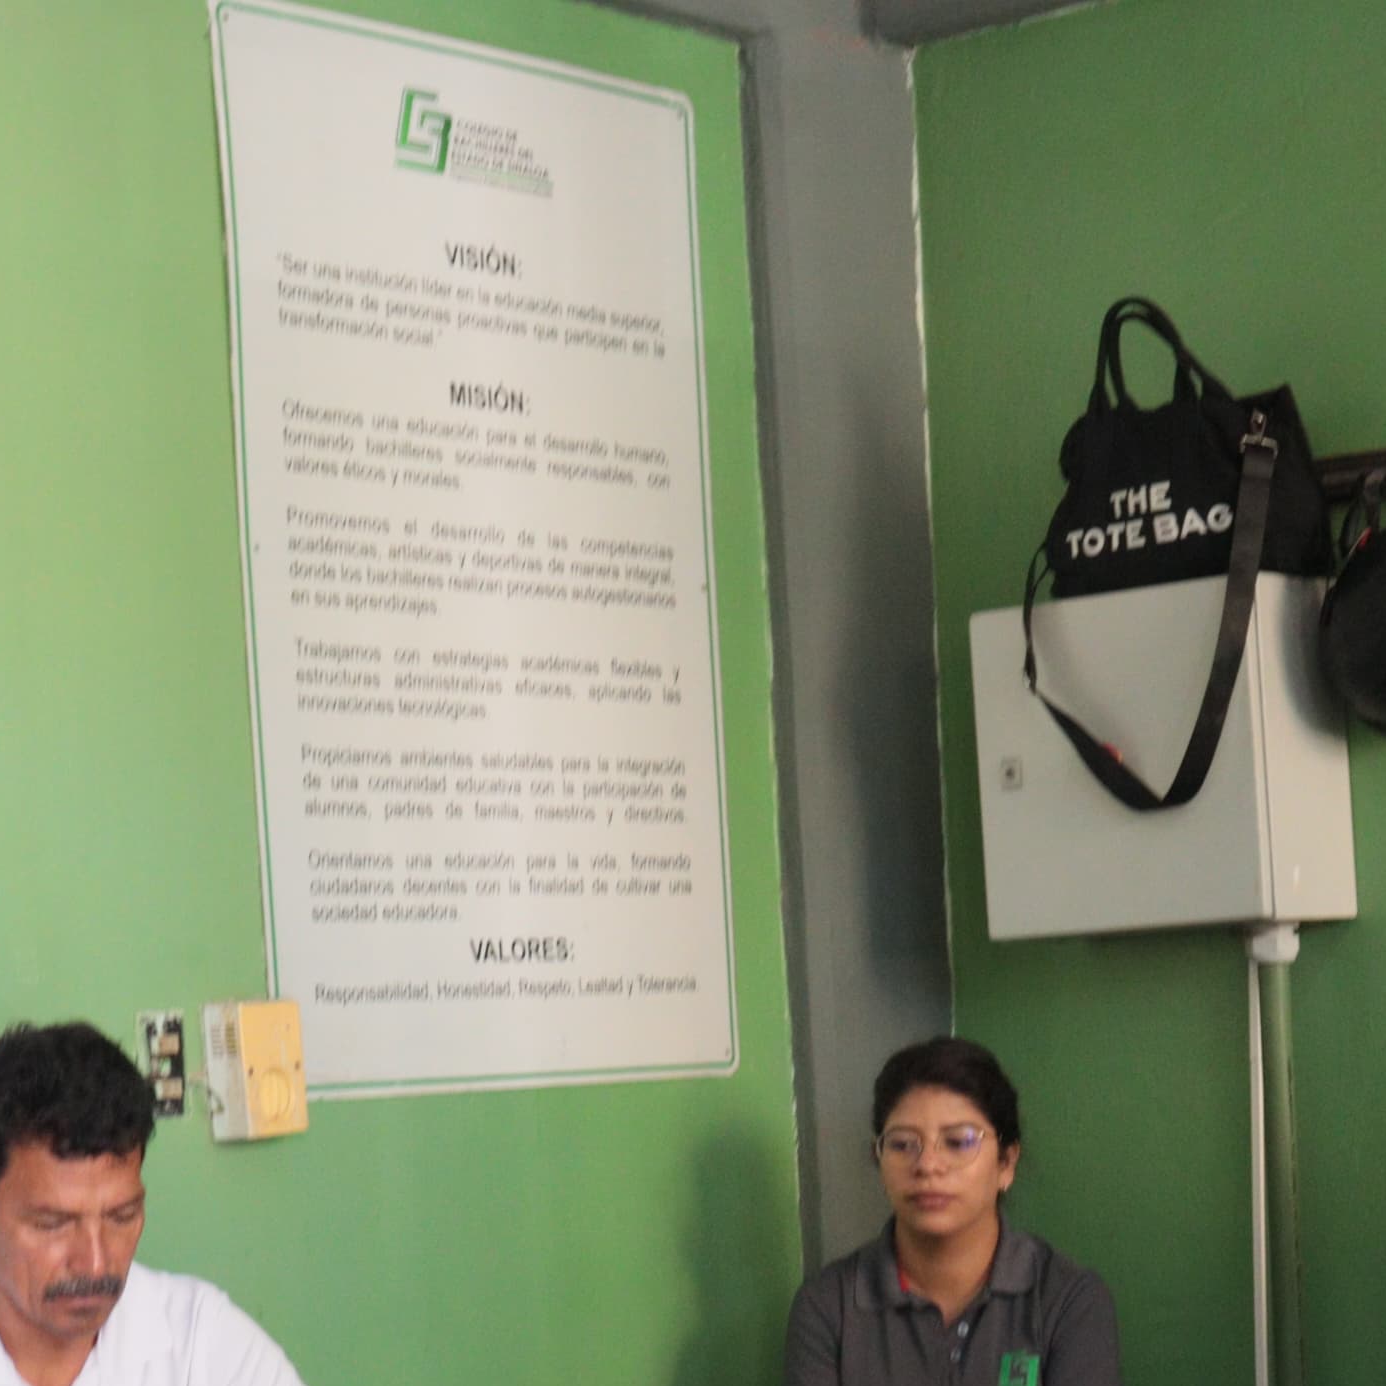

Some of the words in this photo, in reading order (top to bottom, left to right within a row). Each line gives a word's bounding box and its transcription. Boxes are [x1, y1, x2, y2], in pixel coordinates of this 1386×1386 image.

[445, 242, 522, 278] VISIÓN:
[312, 261, 340, 280] una
[456, 285, 474, 302] en
[478, 285, 490, 305] la
[360, 292, 378, 313] de
[533, 323, 557, 344] que
[632, 339, 648, 355] en
[653, 339, 666, 358] la
[450, 381, 530, 416] MISIÓN:
[371, 413, 398, 431] una
[524, 429, 536, 448] el
[647, 473, 670, 489] con
[1110, 480, 1171, 519] THE
[404, 516, 417, 535] el
[517, 527, 535, 546] de
[547, 530, 568, 549] las
[1066, 518, 1146, 560] TOTE
[1153, 503, 1233, 544] BAG
[341, 562, 361, 582] los
[548, 555, 564, 574] de
[290, 589, 309, 605] en
[314, 591, 340, 608] sus
[393, 648, 420, 664] con
[663, 685, 681, 703] las
[598, 754, 608, 772] la
[303, 770, 320, 789] de
[331, 775, 358, 790] una
[530, 781, 554, 795] con
[563, 778, 574, 796] la
[670, 782, 686, 799] de
[445, 800, 462, 818] de
[405, 853, 431, 868] una
[567, 851, 578, 869] la
[475, 879, 500, 894] con
[509, 876, 520, 894] la
[592, 876, 607, 893] de
[668, 880, 692, 893] una
[470, 938, 574, 963] VALORES:
